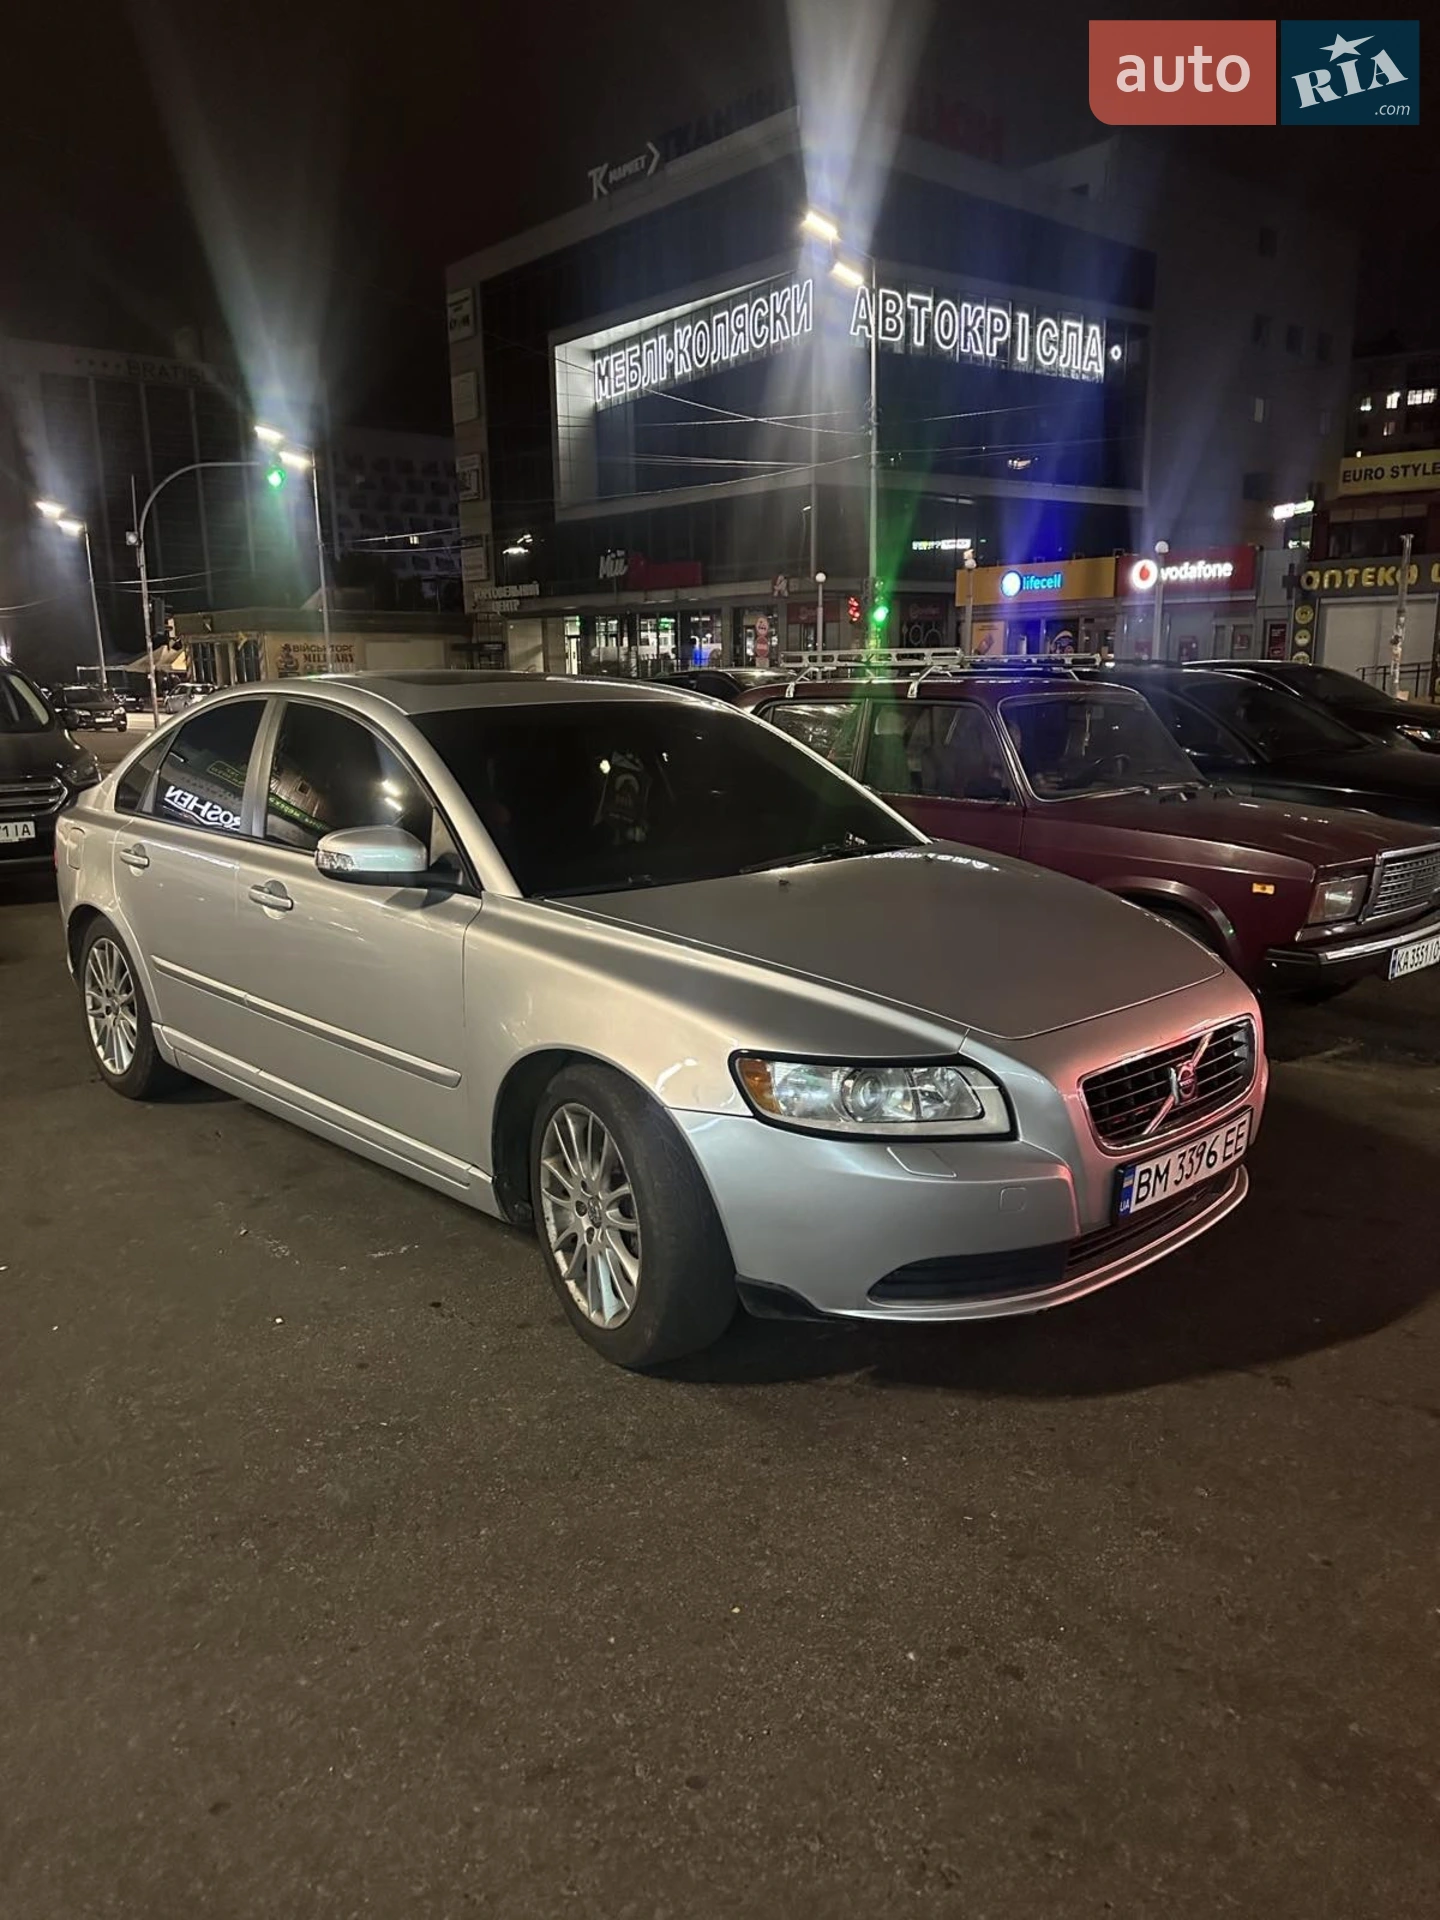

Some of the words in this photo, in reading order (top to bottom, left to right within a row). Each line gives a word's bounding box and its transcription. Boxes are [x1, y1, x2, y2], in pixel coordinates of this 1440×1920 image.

[850, 285, 1105, 373] АВТОКРІСЛА
[1342, 467, 1385, 483] EURO
[1390, 462, 1440, 478] STYLE
[1160, 560, 1233, 580] vodafone
[1022, 573, 1062, 590] lifecell
[15, 824, 31, 836] IA
[1120, 1199, 1130, 1212] UA
[1135, 1158, 1171, 1205] BM
[1174, 1134, 1220, 1186] 3396
[1222, 1119, 1246, 1163] EE
